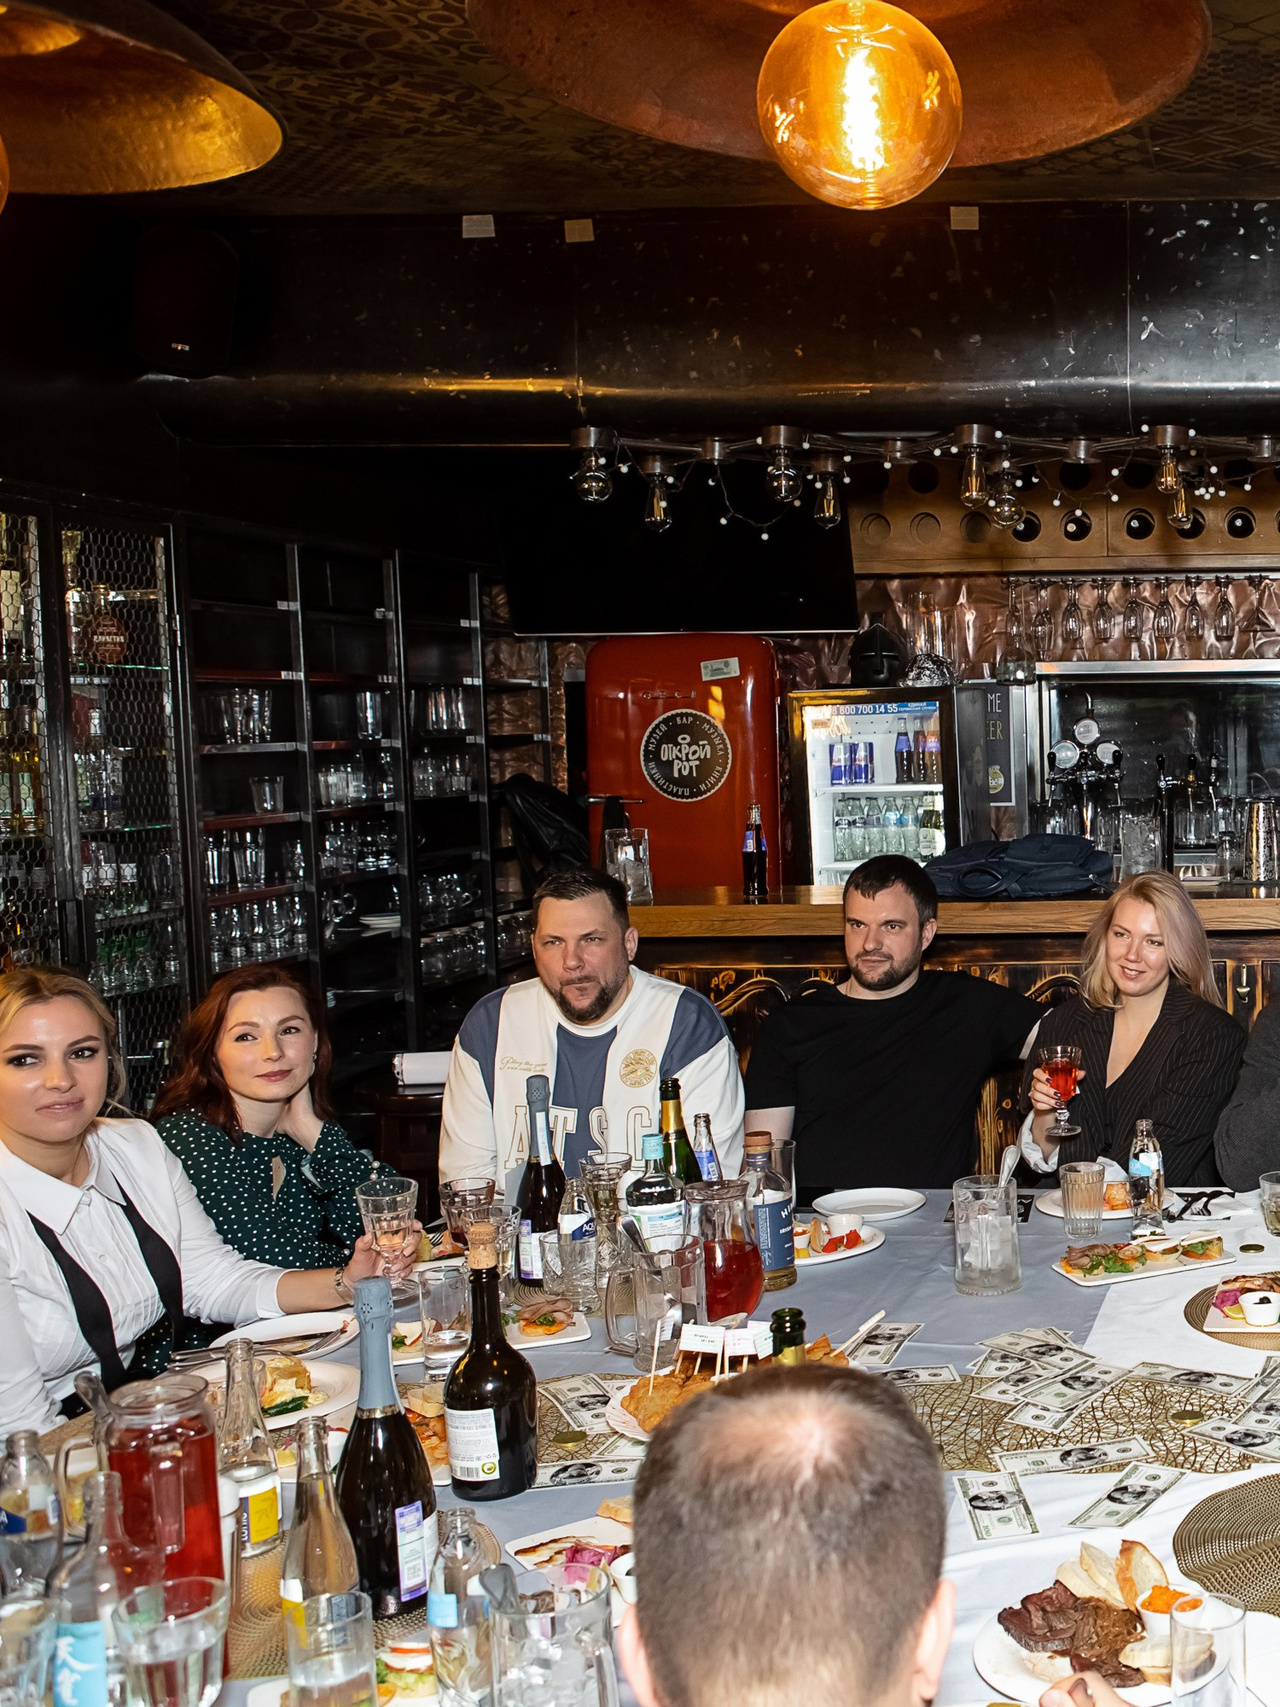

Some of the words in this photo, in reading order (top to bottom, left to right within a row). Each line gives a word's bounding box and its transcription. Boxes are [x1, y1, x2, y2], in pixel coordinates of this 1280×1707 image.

[676, 716, 694, 725] БАР
[839, 706, 856, 715] 800
[857, 705, 875, 714] 700
[875, 704, 885, 714] 14
[887, 703, 899, 713] 55
[647, 723, 668, 751] МУЗЕЙ
[701, 722, 725, 756] МУЗЫКА
[660, 740, 712, 761] ОТКРОЙ
[648, 761, 690, 796] ПЛАСТИНКИ
[673, 760, 700, 778] РОТ
[698, 765, 723, 792] КНИГИ
